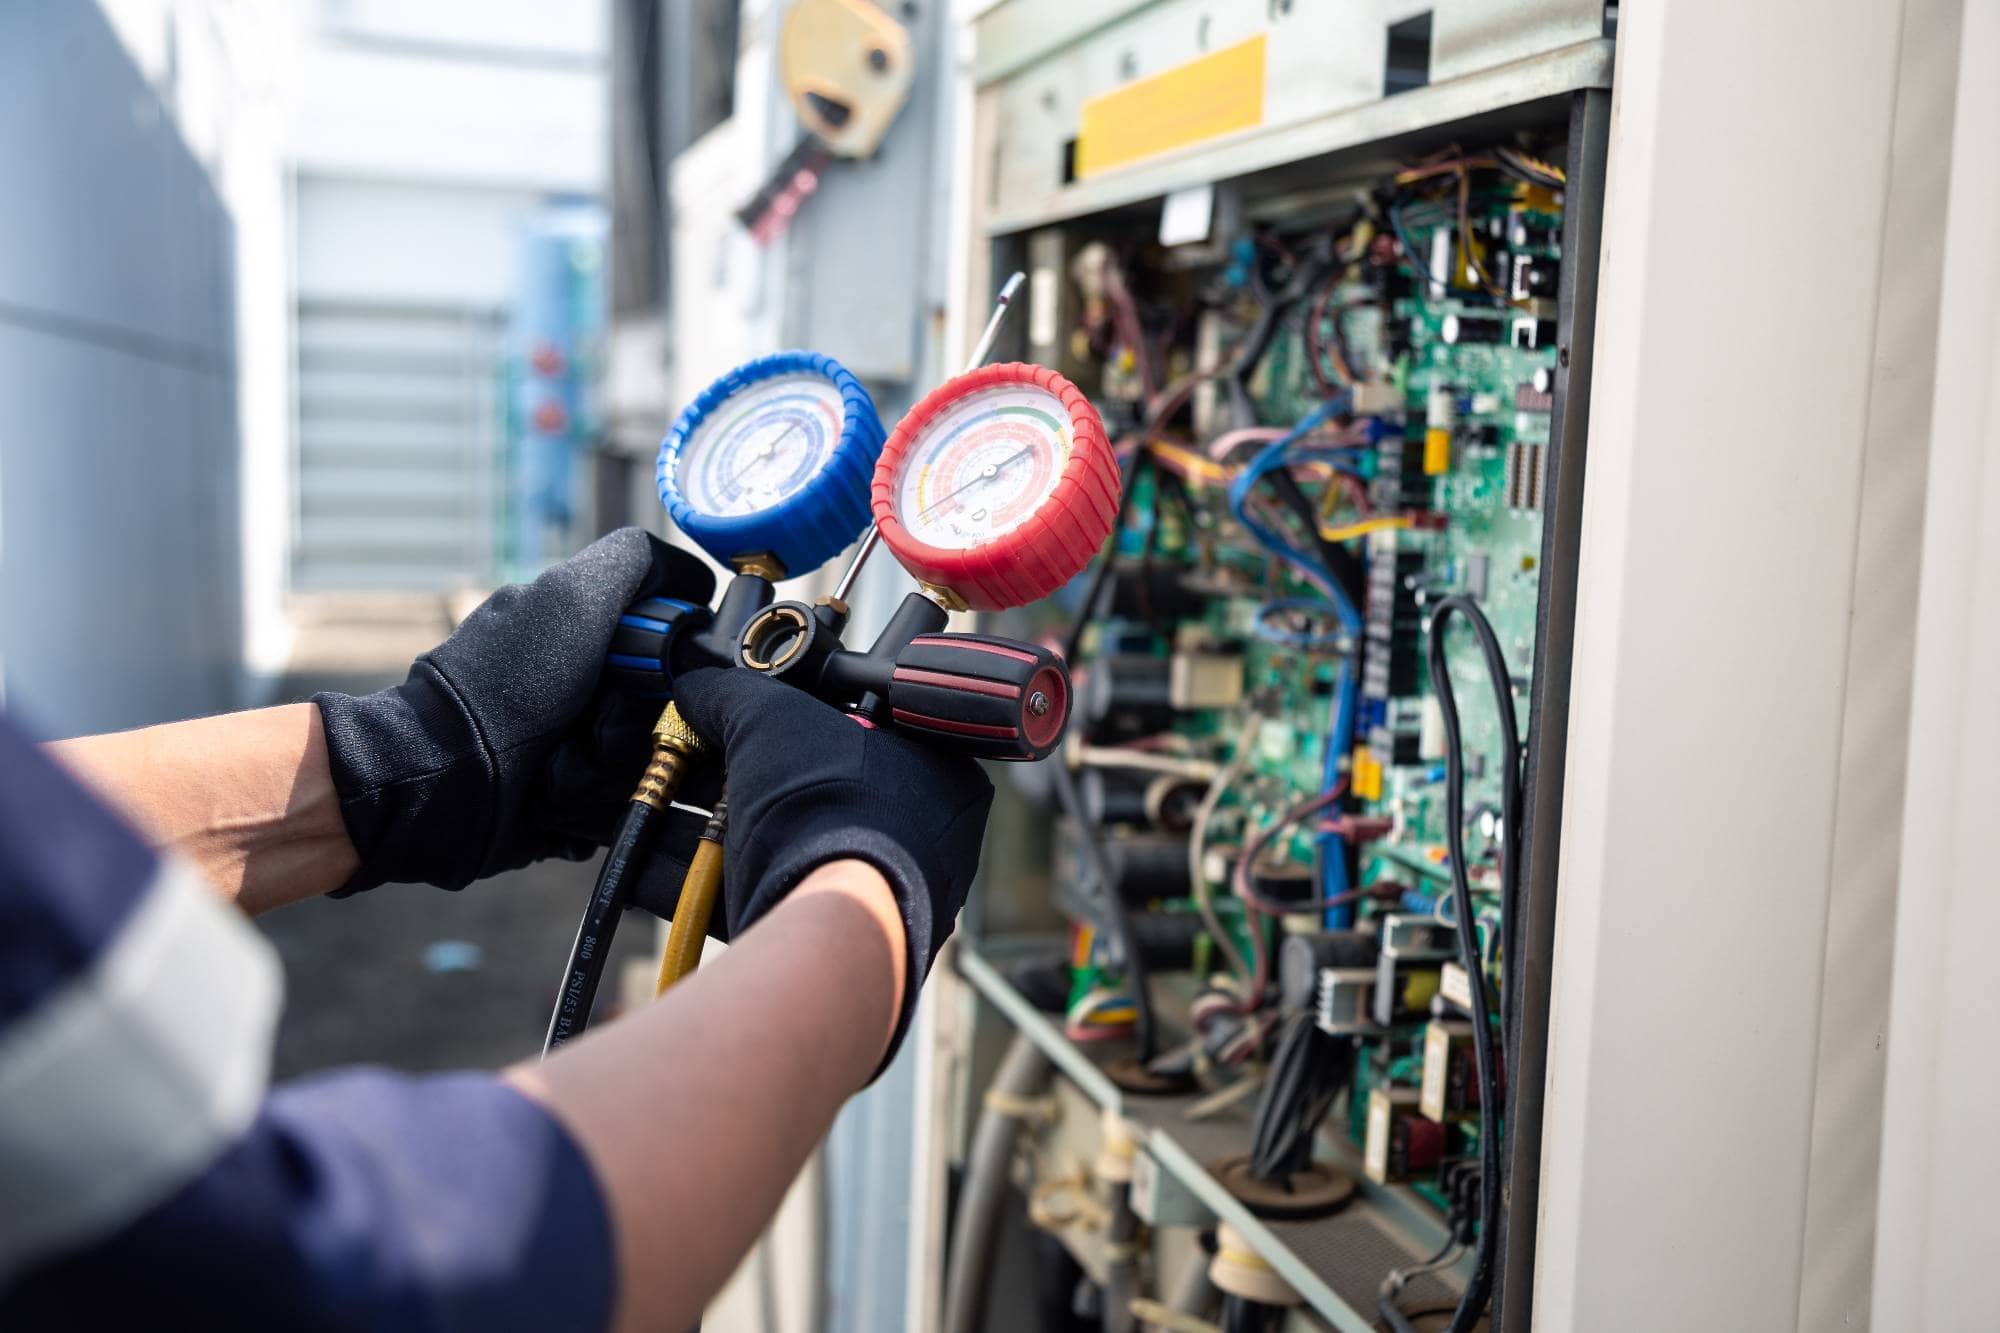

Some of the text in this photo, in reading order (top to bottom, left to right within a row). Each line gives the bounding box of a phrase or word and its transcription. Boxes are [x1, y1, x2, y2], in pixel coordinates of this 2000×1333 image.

[623, 817, 645, 848] BAR
[600, 859, 626, 908] BURST
[581, 935, 598, 960] 800
[564, 970, 586, 1014] PSI/55
